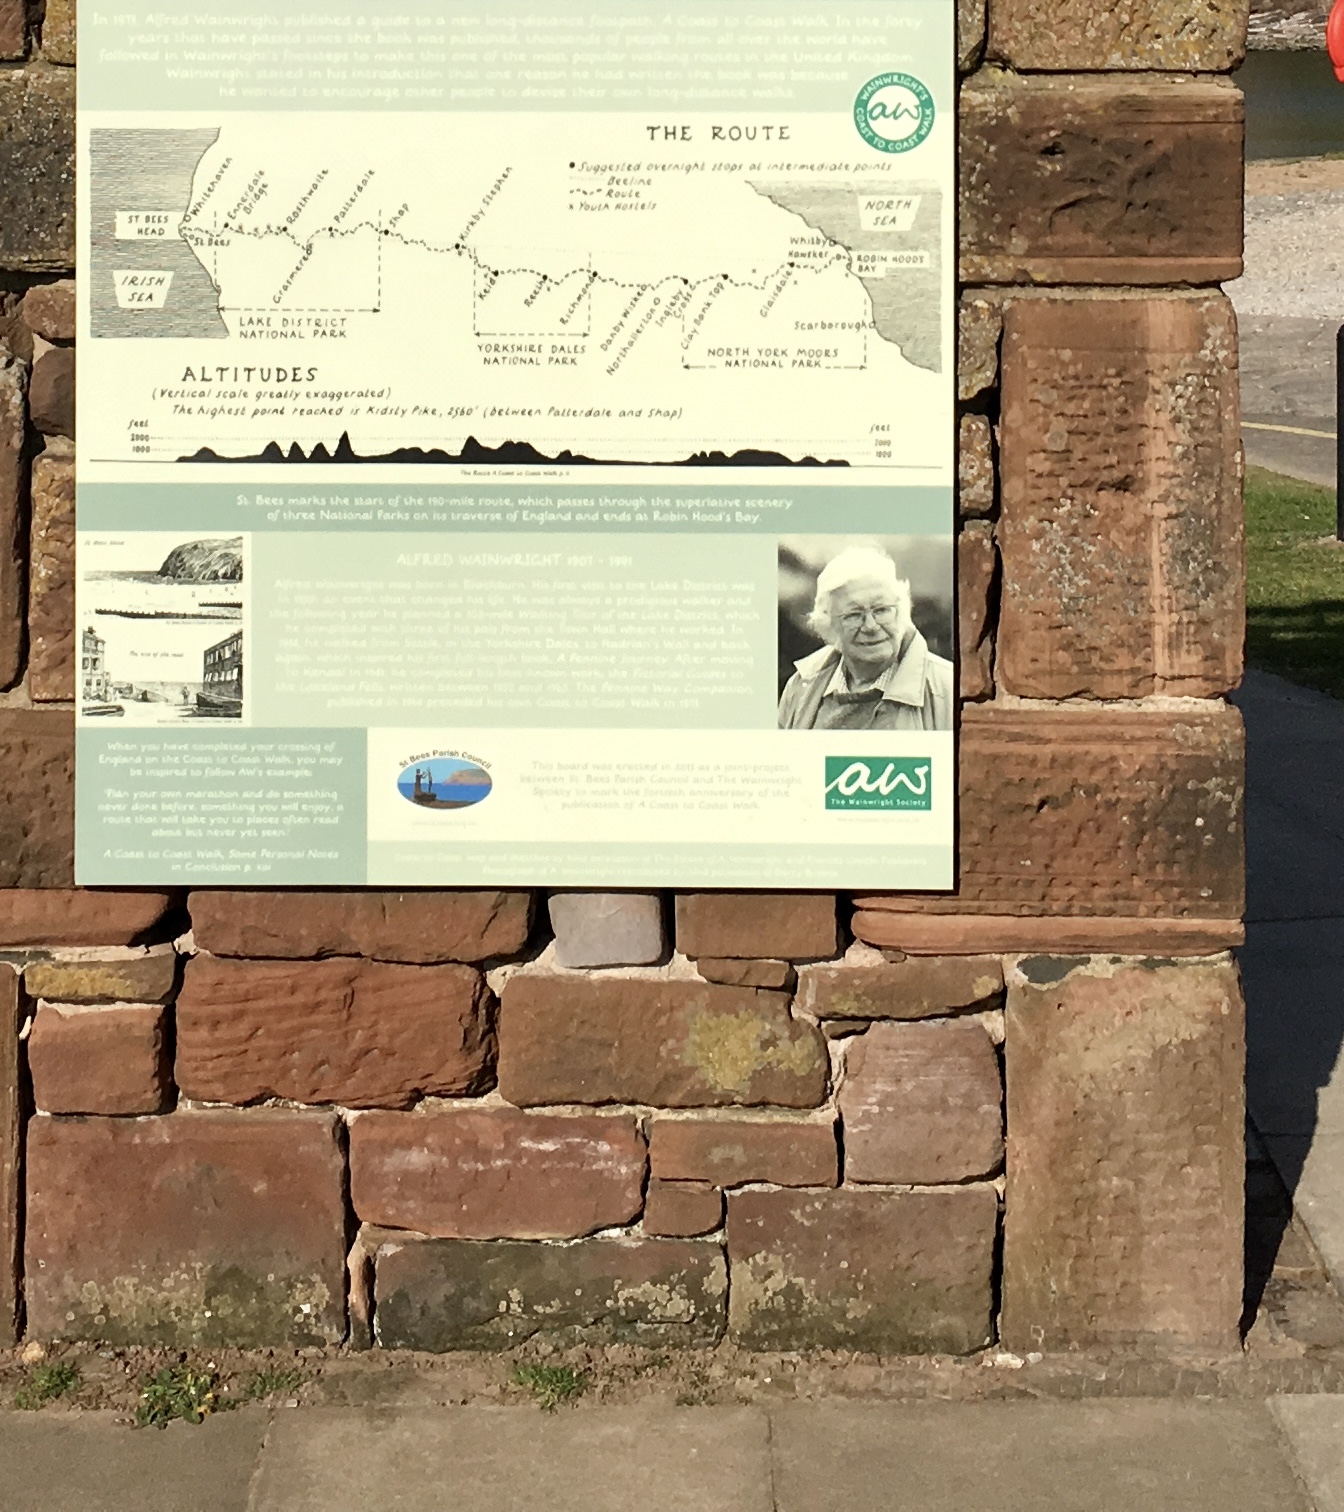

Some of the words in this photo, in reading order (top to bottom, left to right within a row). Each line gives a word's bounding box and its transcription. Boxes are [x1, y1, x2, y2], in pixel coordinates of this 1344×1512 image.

[145, 14, 189, 28] Alfred
[194, 14, 278, 30] Wainwright
[284, 14, 351, 30] published
[356, 16, 365, 26] a
[860, 75, 928, 101] WAINWRIGHT'S
[647, 125, 693, 141] THE
[711, 125, 791, 141] ROUTE
[856, 107, 874, 138] COAST
[873, 137, 885, 148] TO
[888, 134, 919, 151] COAST
[919, 107, 932, 136] WALK
[578, 161, 641, 175] Suggested
[646, 161, 706, 175] overnight
[712, 162, 742, 174] stops
[749, 162, 762, 171] at
[767, 162, 850, 171] intermediate
[853, 163, 892, 174] points
[190, 156, 233, 217] Whitehaven
[607, 176, 652, 186] Beeline
[227, 168, 265, 220] Ennerdale
[243, 182, 270, 216] Bridge
[285, 168, 329, 225] Rosthwaite
[334, 168, 375, 223] Patterdale
[605, 189, 641, 199] Route
[459, 210, 486, 241] Kirkby
[482, 166, 513, 207] Stephen
[578, 201, 610, 212] Youth
[614, 201, 657, 211] Hostels
[865, 199, 912, 210] NORTH
[127, 214, 140, 224] ST
[143, 214, 169, 224] BEES
[389, 203, 410, 228] Shap
[873, 216, 896, 226] SEA
[137, 227, 165, 236] HEAD
[208, 237, 231, 247] Bees
[790, 236, 827, 248] Whitby
[857, 254, 887, 263] ROBIN
[858, 265, 876, 273] BAY
[121, 275, 167, 287] IRISH
[273, 254, 309, 304] Grasmere
[128, 292, 154, 302] SEA
[559, 276, 595, 326] Richmond
[655, 288, 684, 328] Ingleby
[673, 292, 692, 319] Cross
[239, 317, 272, 327] LAKE
[282, 317, 347, 327] DISTRICT
[681, 327, 699, 350] Clay
[693, 301, 712, 326] Bank
[708, 282, 725, 298] Top
[794, 320, 868, 332] Scarborough
[239, 329, 304, 339] NATIONAL
[313, 329, 347, 338] PARK
[600, 320, 625, 351] Danby
[477, 344, 543, 354] YORKSHIRE
[551, 344, 586, 354] DALES
[606, 308, 656, 376] Northallerton
[707, 348, 748, 358] NORTH
[755, 348, 789, 358] YORK
[796, 348, 839, 358] MOORS
[483, 356, 541, 366] NATIONAL
[548, 356, 577, 366] PARK
[724, 359, 783, 369] NATIONAL
[792, 359, 822, 369] PARK
[182, 366, 319, 383] ALTITUDES
[152, 387, 211, 400] (Vertical
[216, 389, 249, 399] scale
[255, 388, 300, 401] greatly
[306, 387, 391, 401] exaggerated)
[173, 405, 193, 415] The
[197, 405, 246, 419] highest
[251, 406, 285, 419] point
[292, 406, 343, 416] reached
[350, 407, 360, 416] is
[412, 405, 443, 418] Pike,
[483, 406, 541, 419] (between
[547, 406, 612, 418] Patterdale
[618, 408, 643, 418] and
[648, 408, 682, 420] Shap)
[127, 419, 148, 430] feet
[256, 496, 284, 506] Bees
[287, 496, 327, 506] marks
[330, 496, 349, 506] the
[354, 496, 384, 506] start
[387, 495, 402, 508] of
[404, 496, 424, 506] the
[428, 496, 475, 506] 190-mile
[517, 497, 553, 507] which
[557, 498, 595, 509] passes
[598, 497, 647, 510] through
[651, 498, 671, 508] the
[675, 498, 741, 510] superlative
[745, 499, 793, 510] scenery
[267, 510, 280, 522] of
[283, 510, 316, 521] three
[320, 510, 373, 521] National
[377, 510, 410, 521] Parks
[413, 512, 428, 521] on
[432, 510, 447, 521] its
[451, 511, 502, 521] traverse
[506, 510, 518, 523] of
[522, 511, 572, 524] England
[575, 511, 599, 521] and
[603, 511, 631, 522] ends
[635, 512, 649, 522] at
[653, 511, 688, 522] Robin
[692, 511, 731, 522] Hood's
[396, 553, 453, 567] ALFRED
[458, 553, 562, 567] WAINWRIGHT
[567, 555, 593, 567] 1907
[609, 555, 633, 567] 1991
[399, 759, 409, 768] St
[409, 751, 431, 763] Bees
[432, 749, 459, 757] Parish
[461, 751, 492, 770] Council
[831, 798, 845, 806] The
[848, 798, 894, 806] Wainwright
[897, 798, 926, 807] Society
